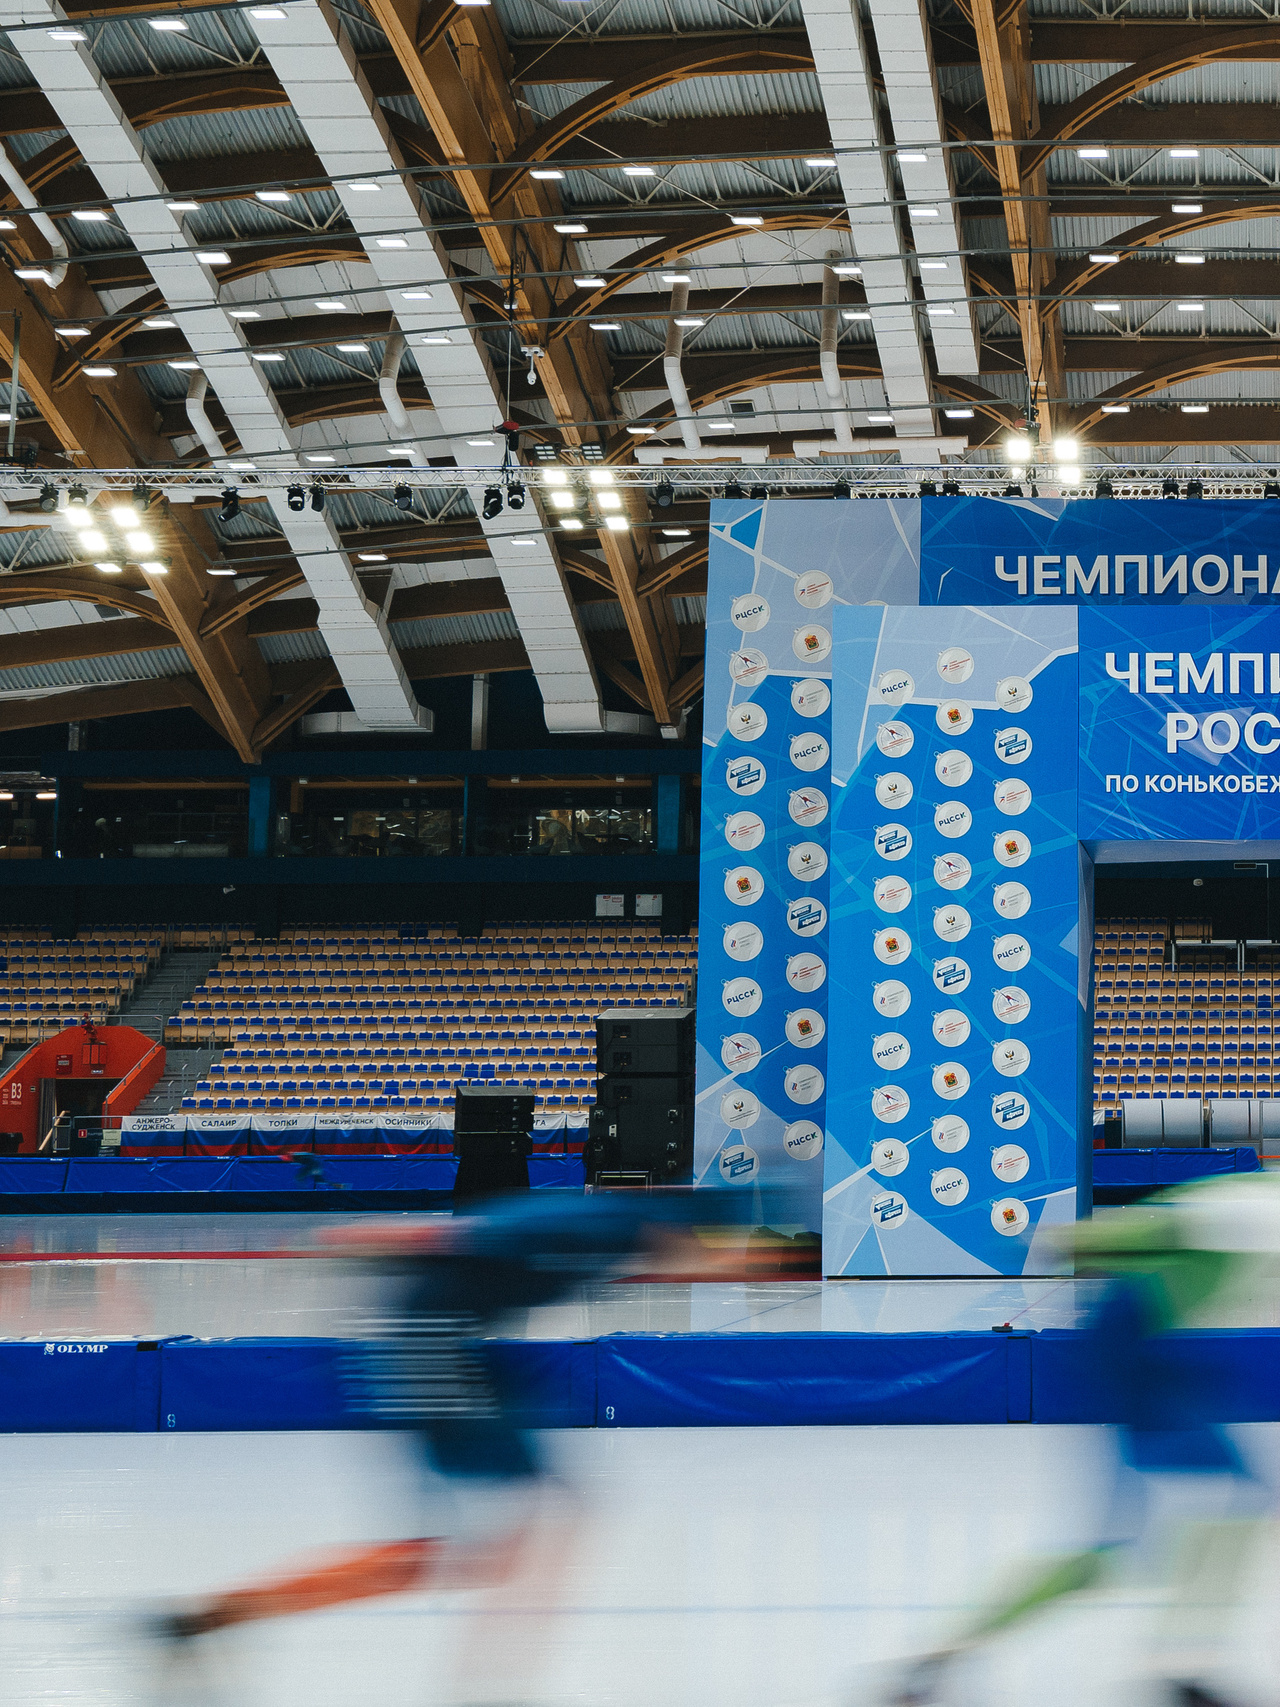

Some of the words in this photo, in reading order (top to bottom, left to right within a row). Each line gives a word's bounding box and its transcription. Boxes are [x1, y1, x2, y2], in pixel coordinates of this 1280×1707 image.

[735, 605, 765, 620] РЦССК
[881, 680, 910, 695] РЦССК
[794, 744, 824, 759] РЦССК
[1105, 774, 1139, 793] ПО
[938, 812, 967, 826] РЦССК
[997, 945, 1026, 960] РЦССК
[726, 989, 757, 1004] РЦССК
[876, 1044, 905, 1058] РЦССК
[201, 1119, 237, 1127] САЛАИР
[269, 1119, 298, 1127] ТОПКИ
[385, 1118, 432, 1126] ОСИННИКИ
[788, 1132, 818, 1148] РЦССК
[935, 1179, 964, 1194] РЦССК
[57, 1344, 108, 1353] OLYMP
